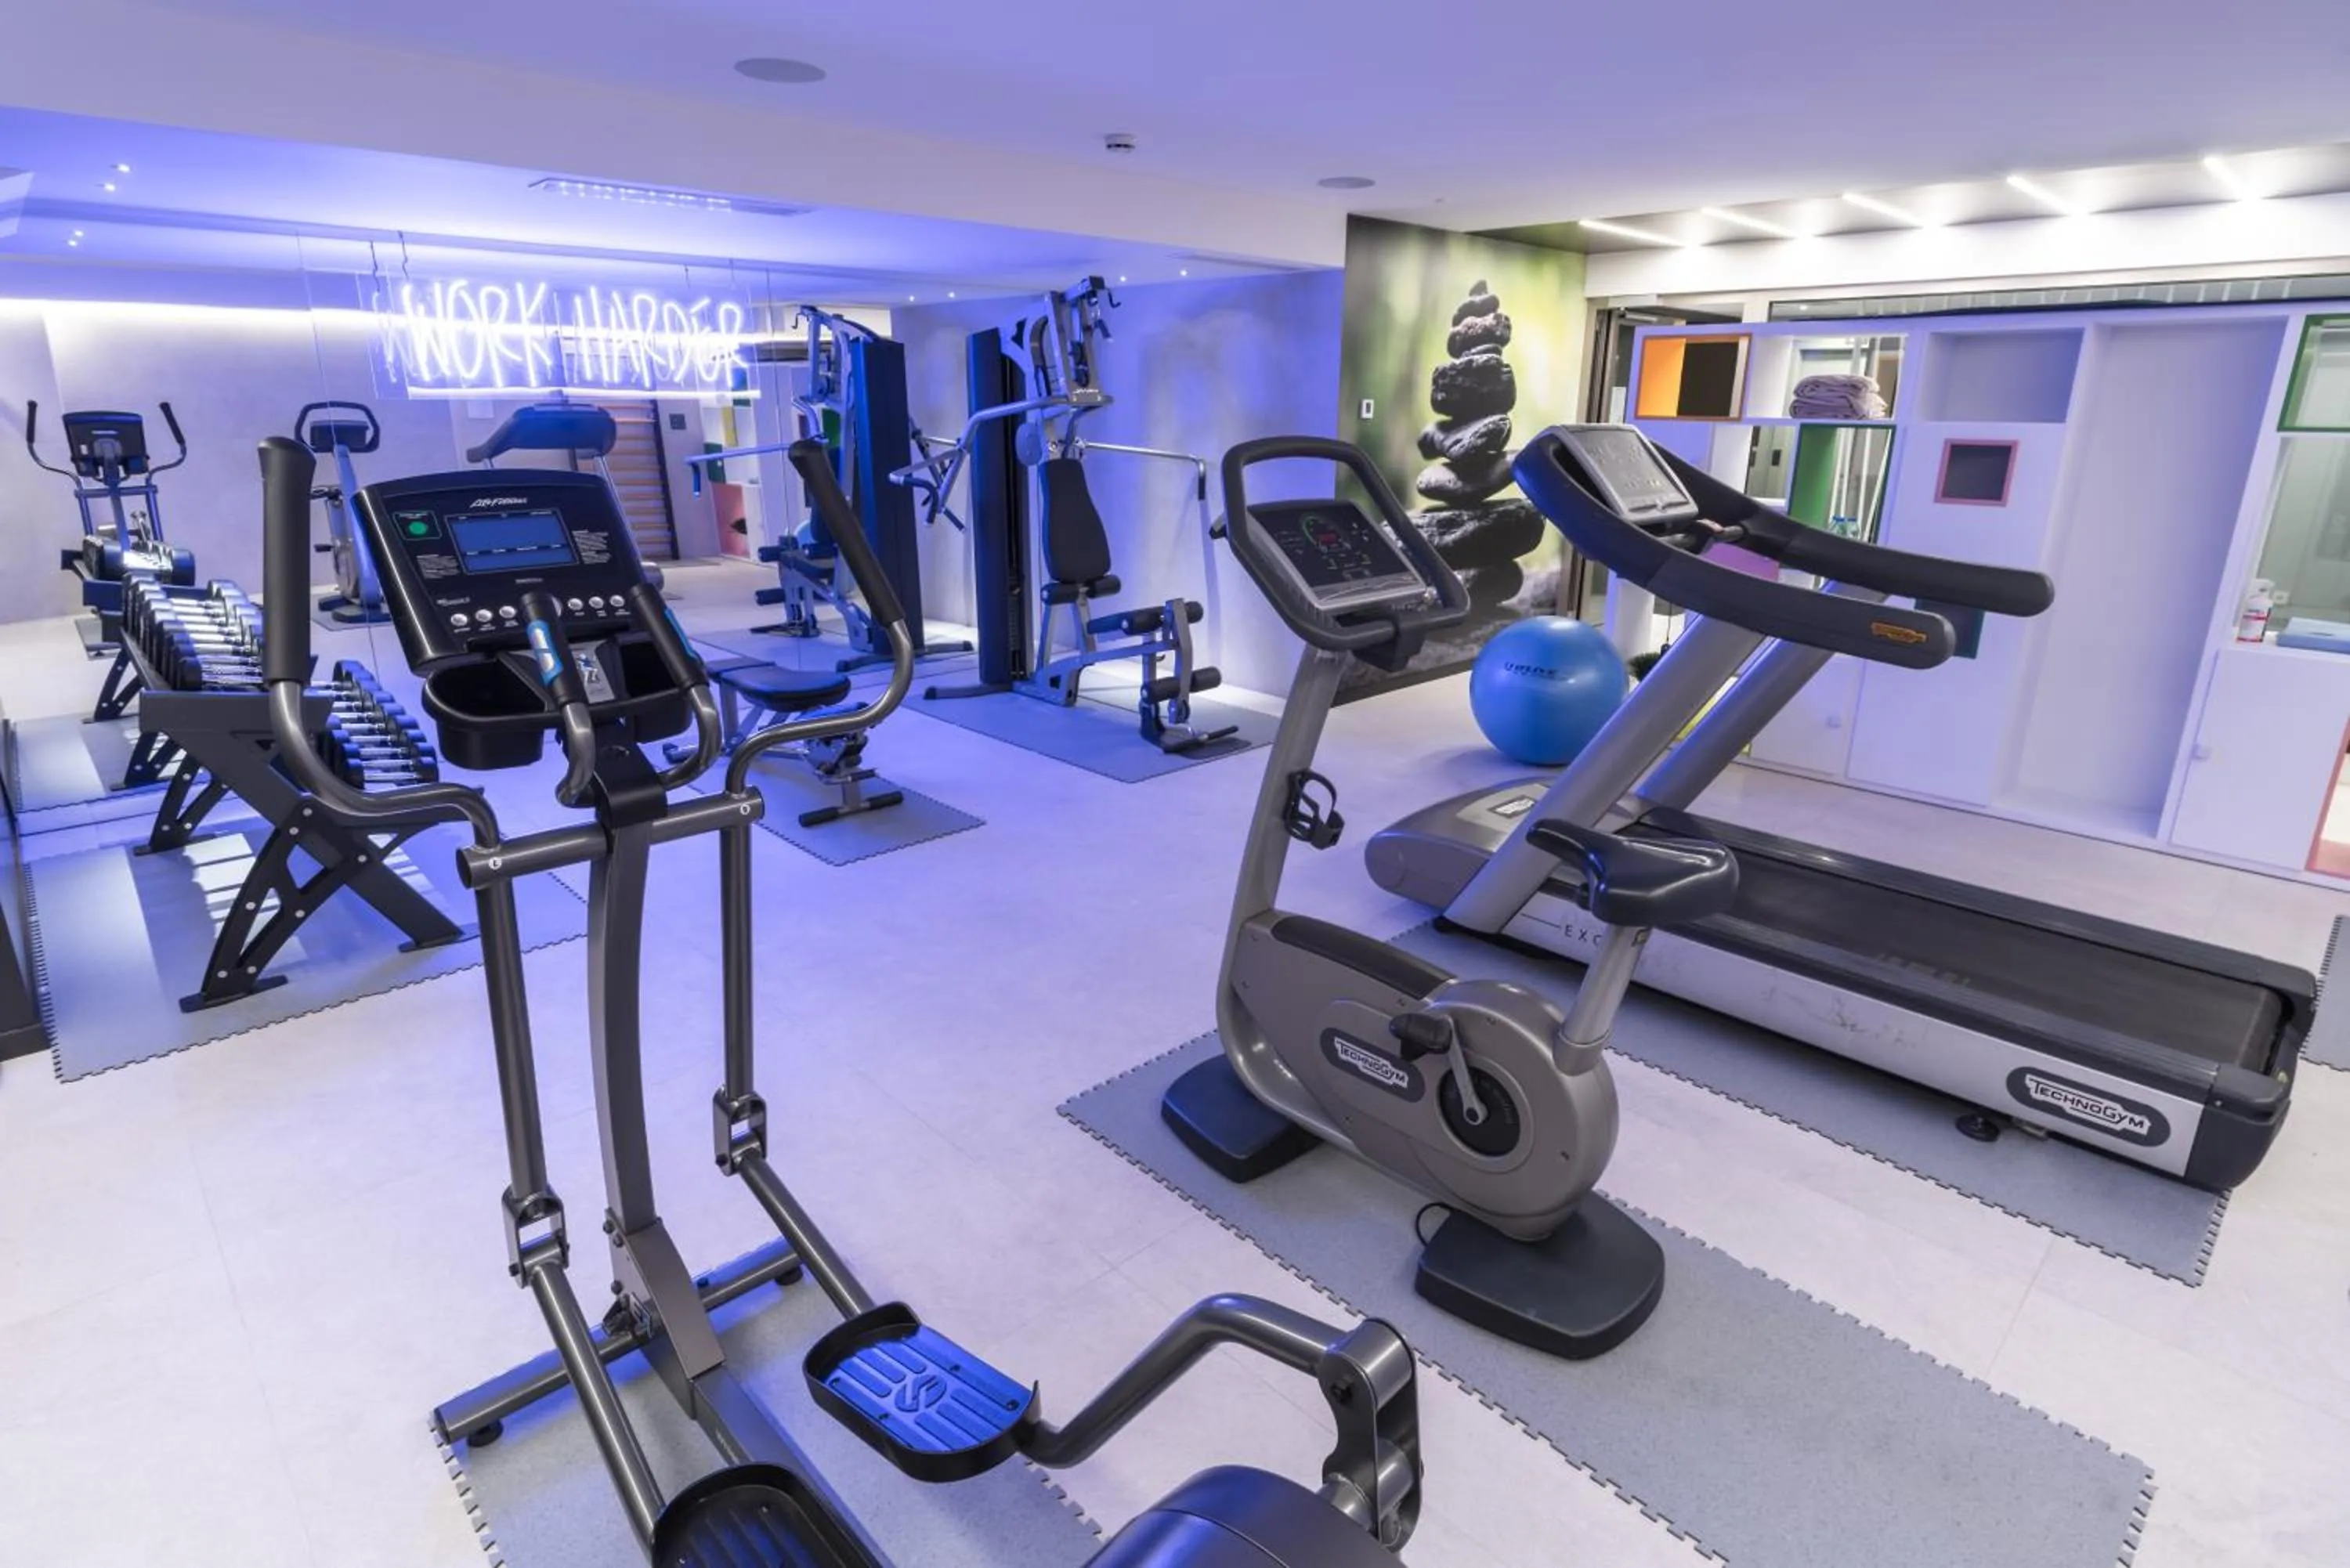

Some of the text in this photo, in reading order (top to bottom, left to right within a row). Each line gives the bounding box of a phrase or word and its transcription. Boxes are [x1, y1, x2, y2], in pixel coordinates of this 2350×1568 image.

[402, 278, 749, 388] WORK HARDER
[2028, 1077, 2146, 1129] TECHNOGYM
